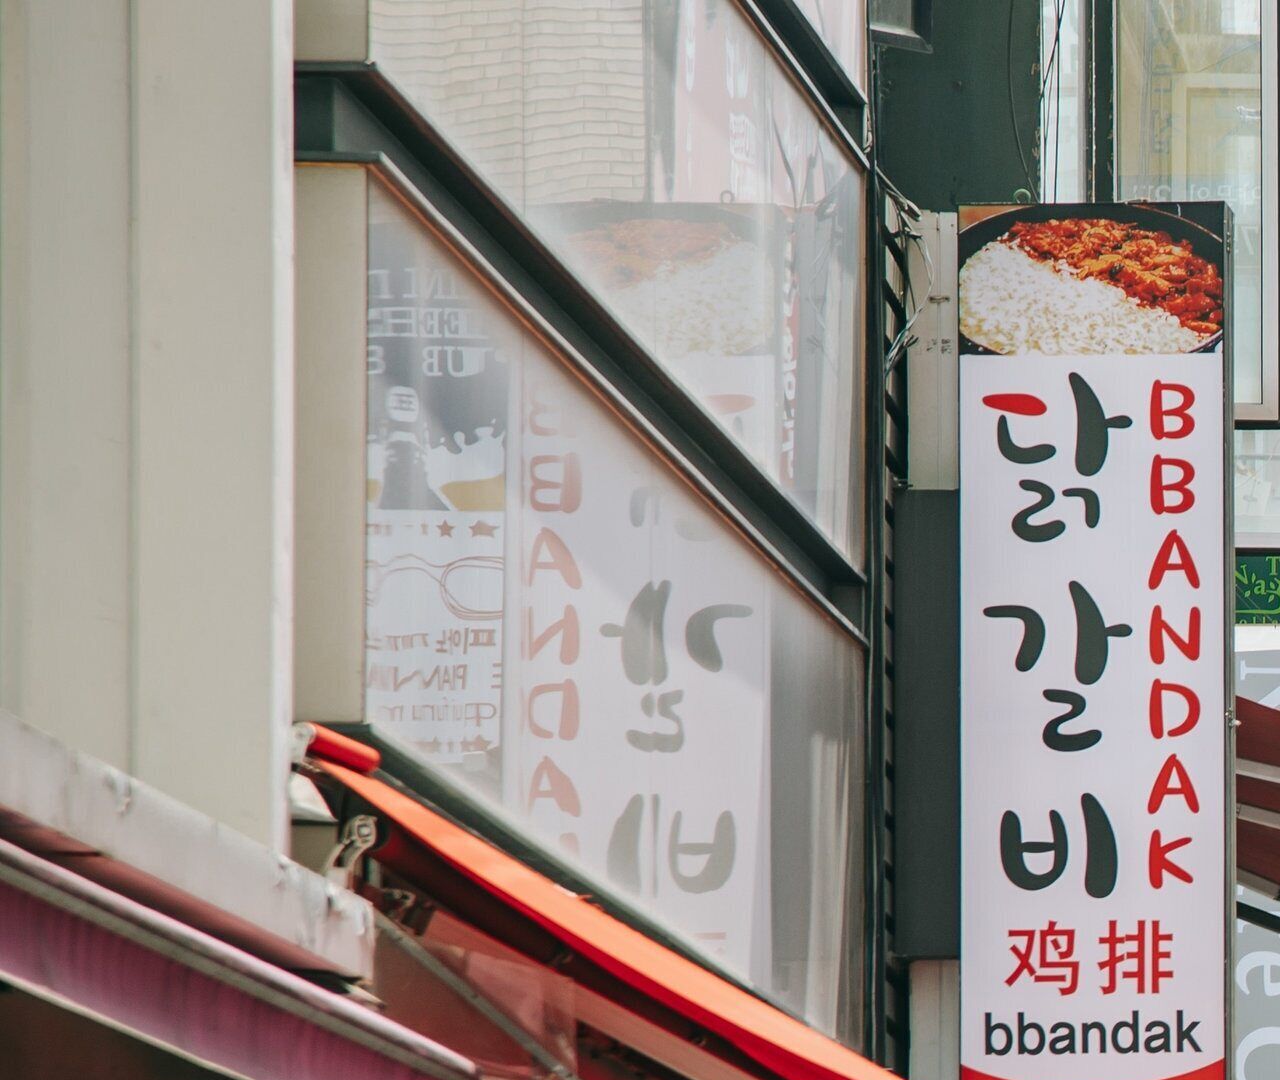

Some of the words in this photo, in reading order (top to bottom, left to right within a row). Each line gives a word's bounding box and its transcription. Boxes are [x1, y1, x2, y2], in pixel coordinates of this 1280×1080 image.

[981, 370, 1133, 899] 닭갈비
[1147, 378, 1203, 890] BBANDAK
[983, 1009, 1203, 1056] bbandak
[1004, 919, 1175, 996] 鸡排
